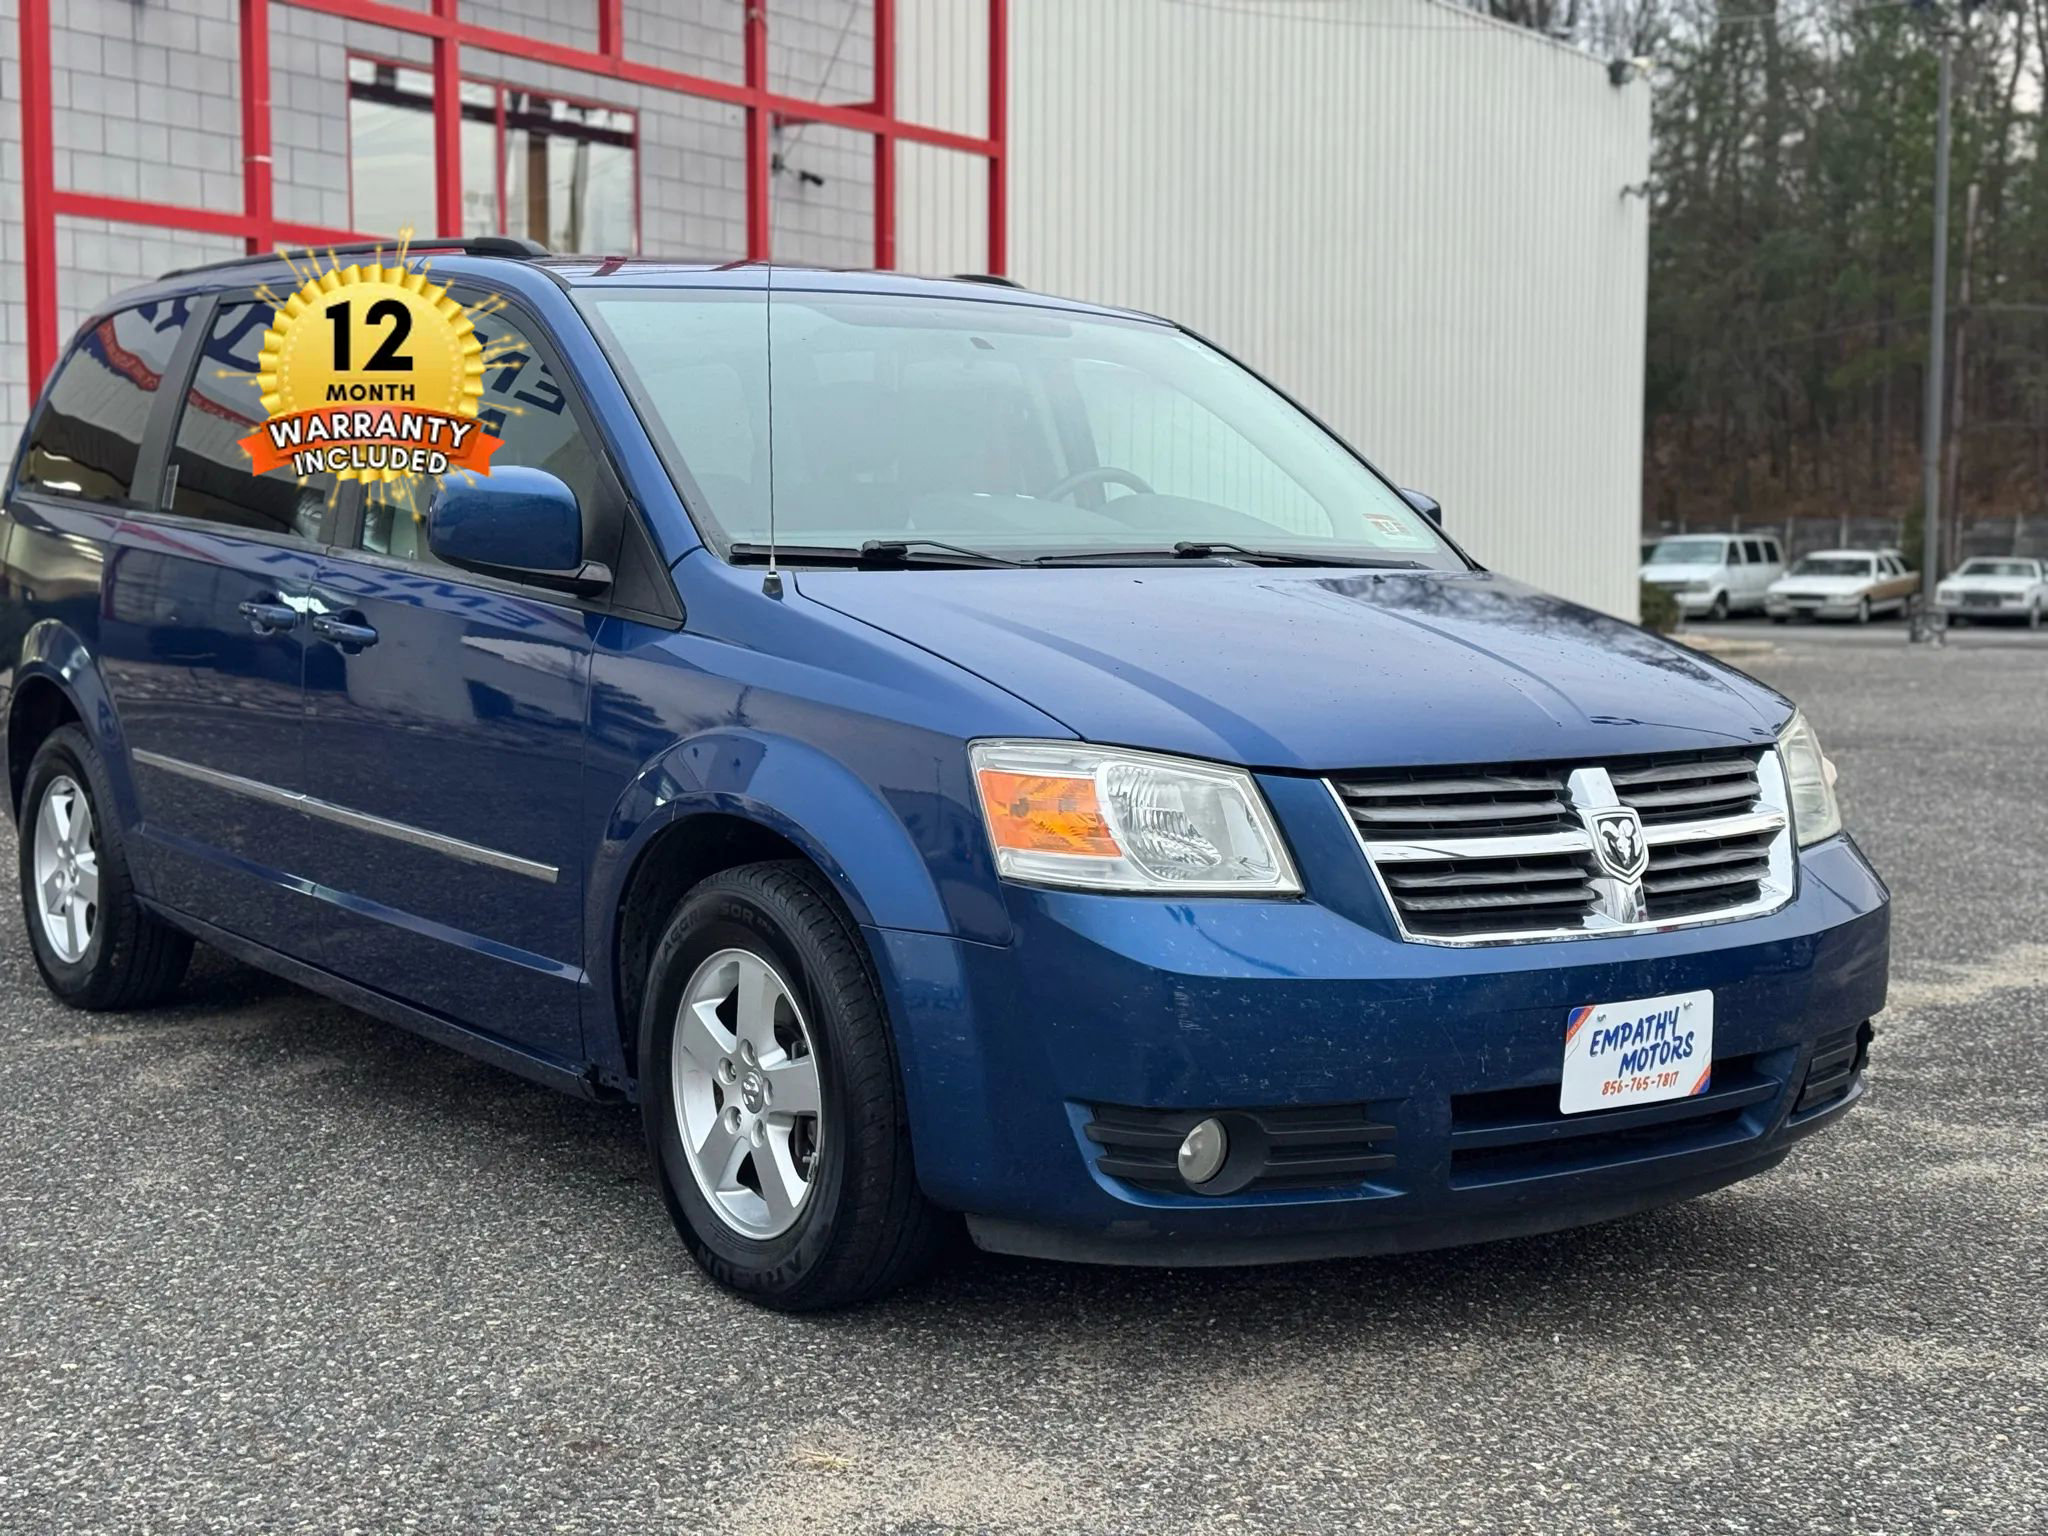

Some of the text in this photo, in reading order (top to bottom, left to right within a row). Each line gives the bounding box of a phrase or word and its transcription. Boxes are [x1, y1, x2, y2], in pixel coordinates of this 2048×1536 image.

[1589, 1005, 1680, 1057] EMPATHY
[1618, 1031, 1695, 1078] MOTORS
[1602, 1071, 1679, 1095] 856-765-7817
